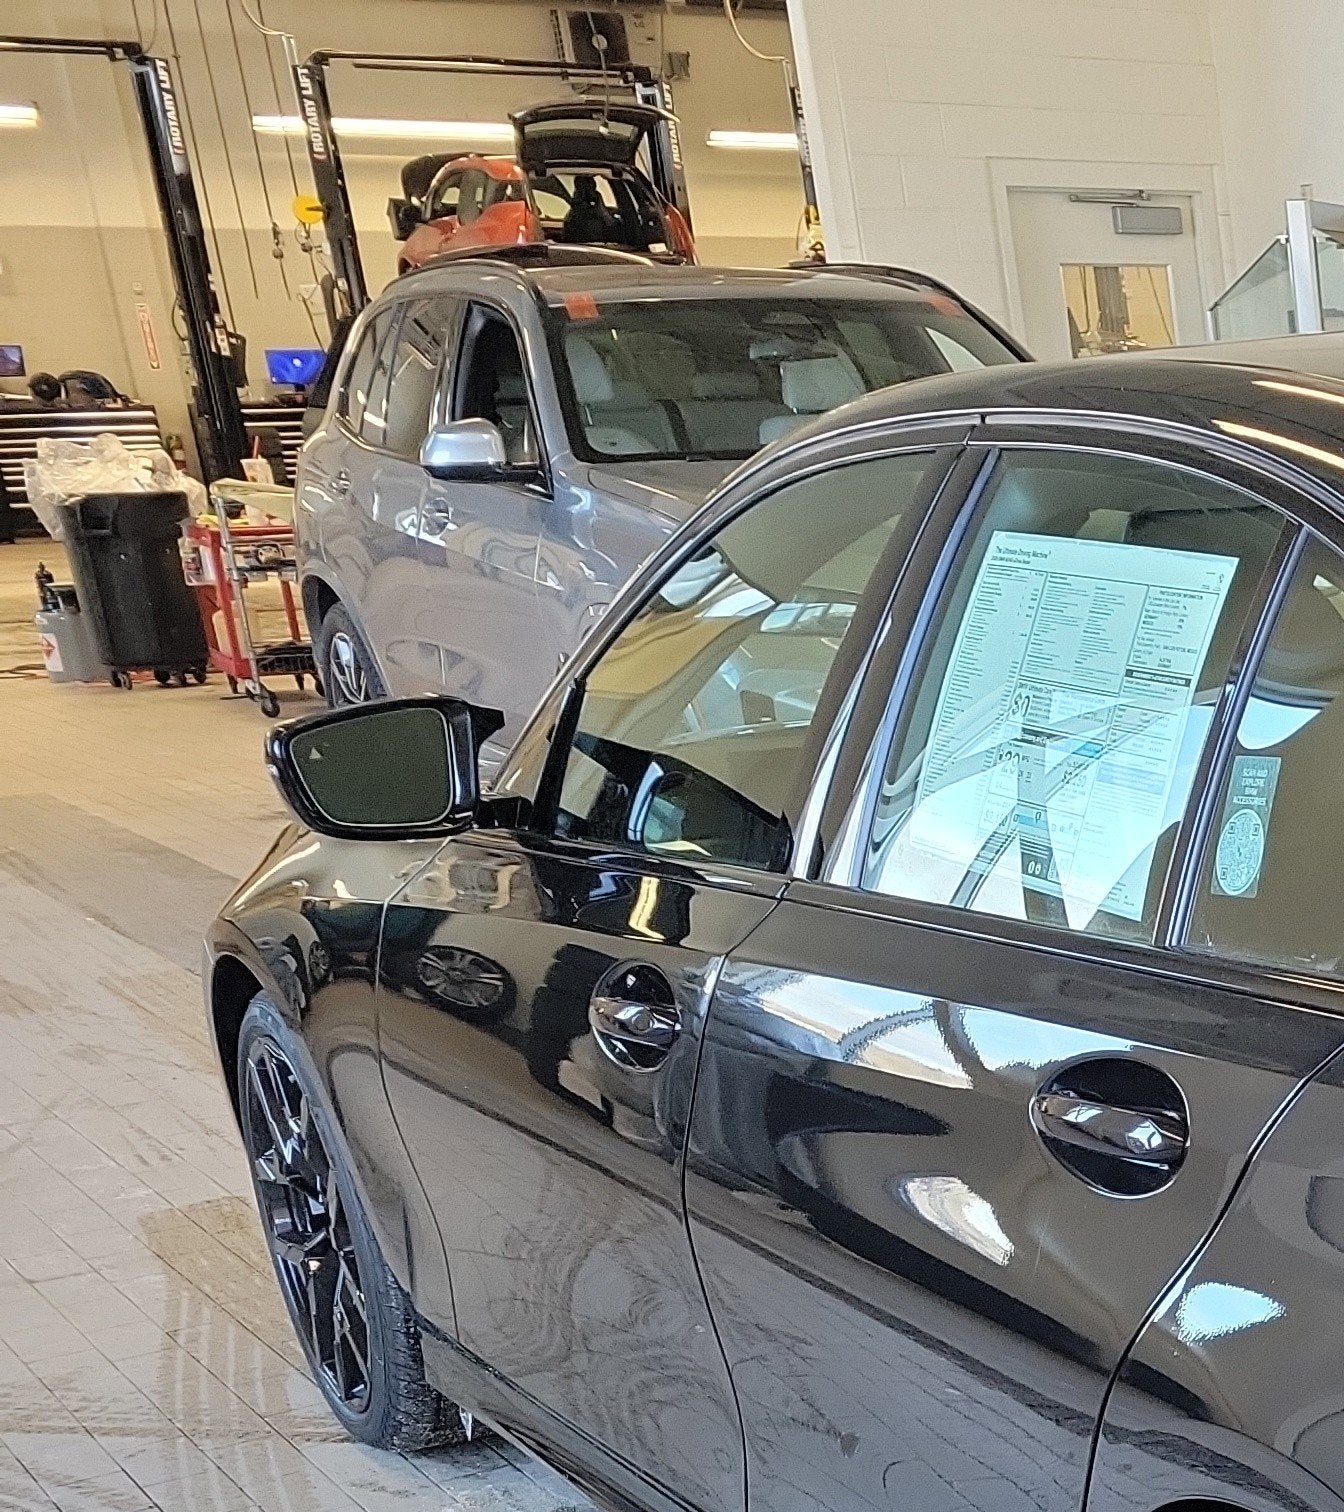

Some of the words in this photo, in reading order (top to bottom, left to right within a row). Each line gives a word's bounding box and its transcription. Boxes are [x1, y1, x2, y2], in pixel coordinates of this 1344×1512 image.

[154, 58, 171, 89] LIFT
[296, 66, 314, 95] LIFT
[661, 81, 673, 110] LIFT
[162, 91, 185, 147] ROTARY
[303, 98, 325, 153] ROTARY
